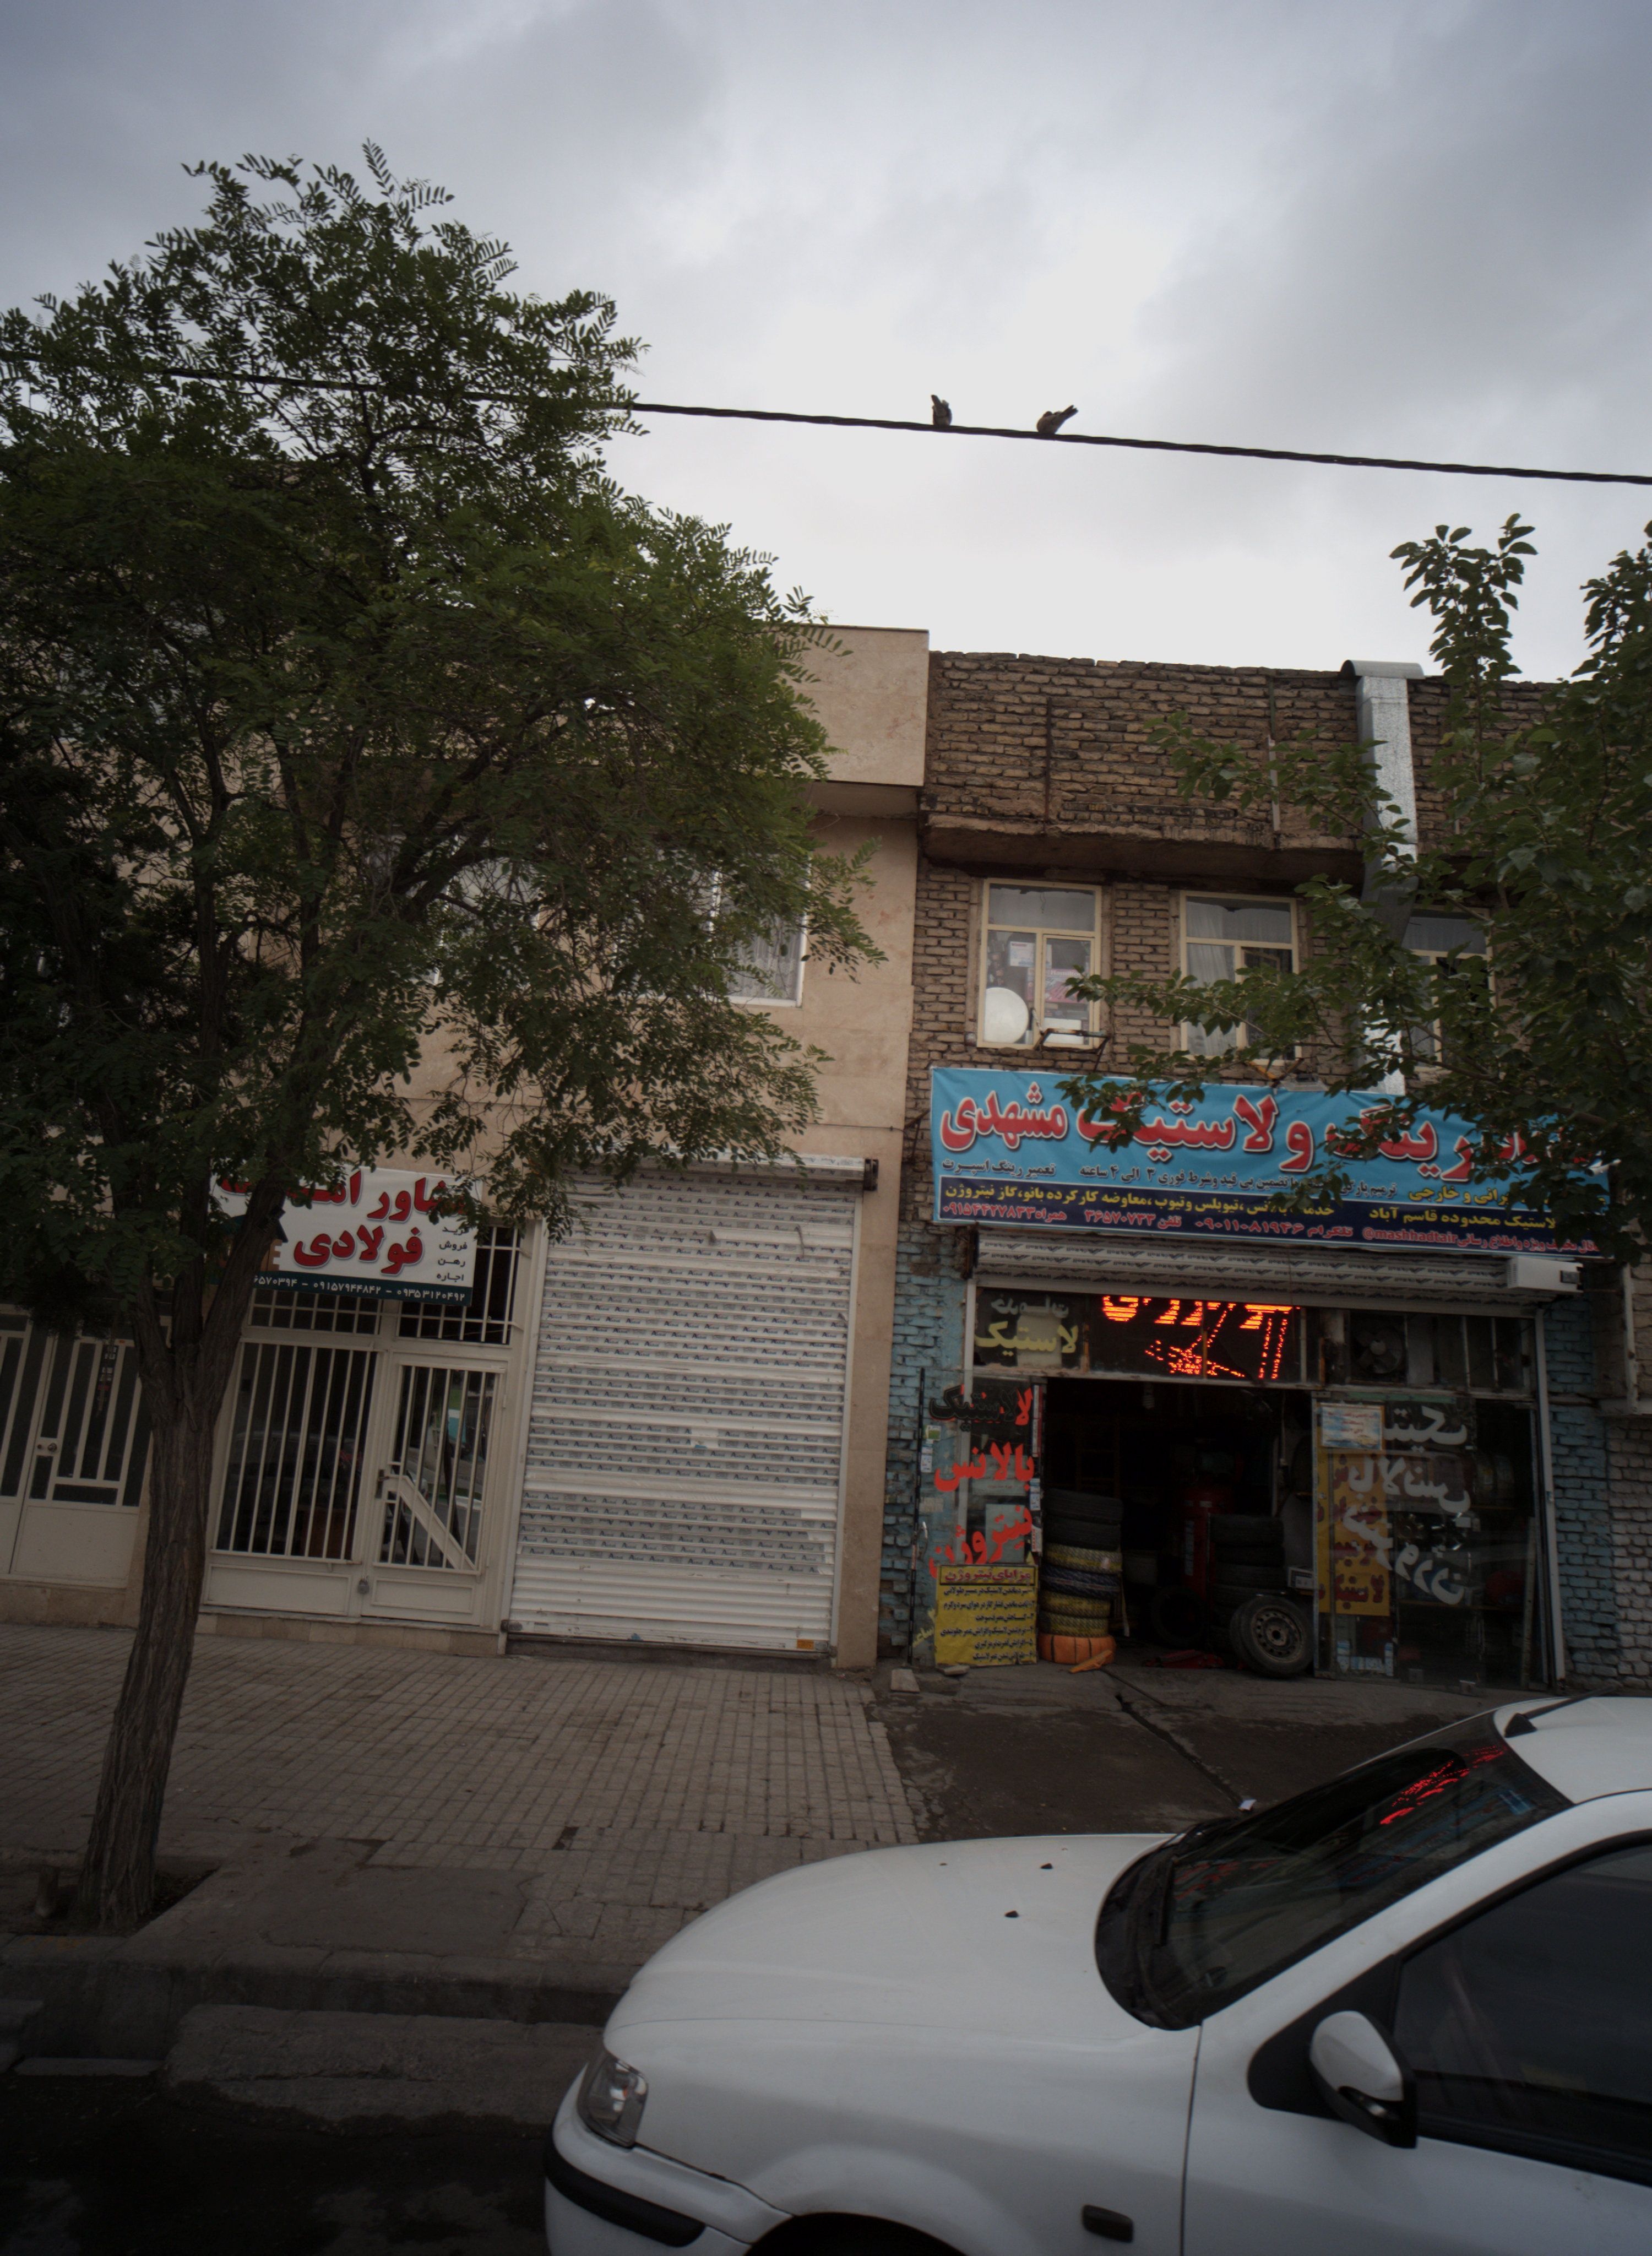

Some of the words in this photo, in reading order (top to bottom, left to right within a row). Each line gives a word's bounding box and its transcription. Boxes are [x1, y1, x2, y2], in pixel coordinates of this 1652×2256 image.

[940, 1081, 1068, 1151] مشهدی
[1284, 1120, 1314, 1173] و
[942, 1158, 991, 1177] اسپرت
[991, 1159, 1023, 1176] رینگ
[1025, 1162, 1056, 1178] تعمیر
[1079, 1164, 1108, 1178] ساعته
[1121, 1166, 1140, 1183] الی
[1158, 1169, 1185, 1186] فوری
[1220, 1174, 1237, 1188] قید
[1240, 1176, 1253, 1189] بی
[1256, 1179, 1289, 1190] تضمین
[945, 1184, 995, 1199] نیتروژن
[1371, 1183, 1397, 1198] ترمیم
[1409, 1185, 1459, 1202] خارجی
[1157, 1214, 1182, 1229] تلفن
[1369, 1206, 1400, 1222] آباد
[1403, 1209, 1438, 1224] قاسم
[1441, 1213, 1501, 1228] محدوده
[1362, 1226, 1458, 1244] @mashhadtair
[294, 1224, 424, 1276] فولادی
[439, 1240, 468, 1251] فروش
[437, 1272, 464, 1282] اجاره
[396, 1288, 466, 1301] ۰۹۳۵۳۱۲۰۴۹۲
[975, 1321, 1079, 1357] لاستیک
[934, 1440, 1035, 1492] بالانس
